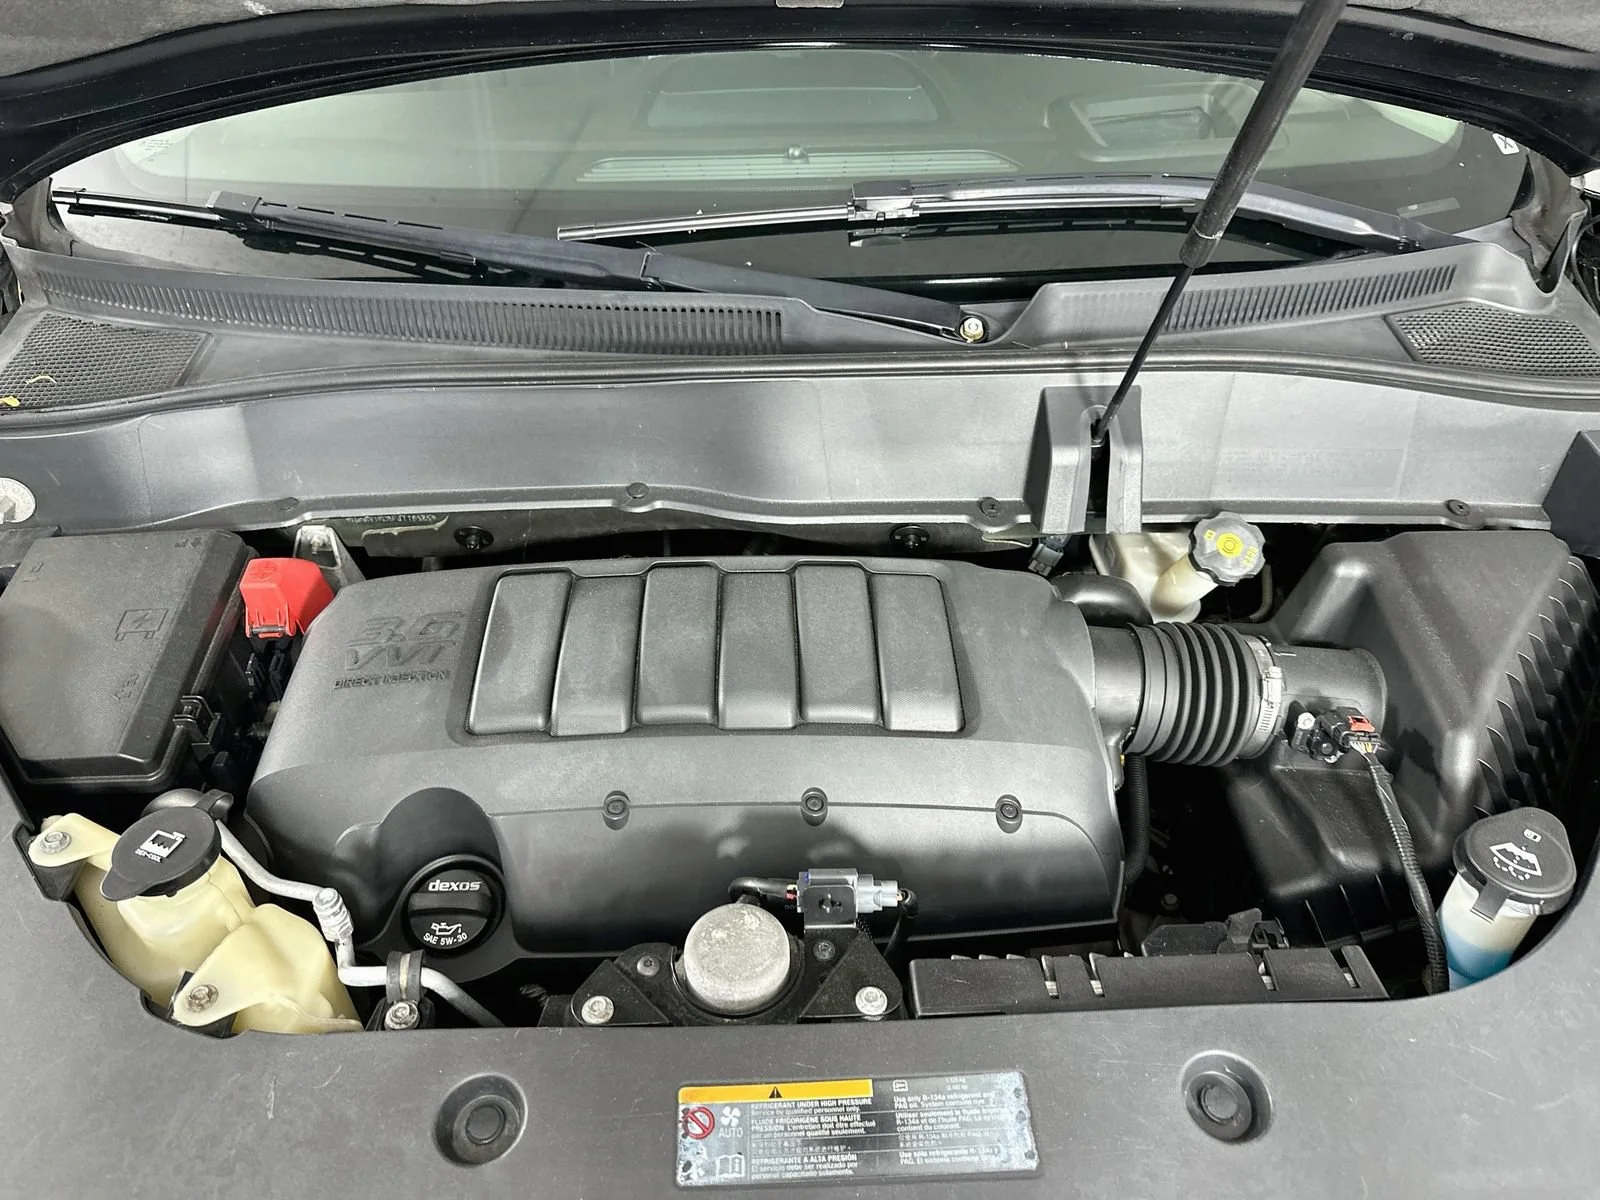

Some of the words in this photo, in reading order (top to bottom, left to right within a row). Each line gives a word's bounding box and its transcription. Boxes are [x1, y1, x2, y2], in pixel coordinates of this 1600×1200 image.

[345, 640, 457, 671] VVT
[334, 675, 380, 689] DIRECT
[382, 670, 451, 684] INJECTION
[428, 880, 482, 891] dexos
[423, 932, 439, 945] SAE
[440, 932, 468, 946] 5W-30
[947, 1092, 981, 1100] refrigerant
[751, 1101, 795, 1109] REFRIGERANT
[838, 1098, 872, 1106] PRESSURE
[921, 1100, 944, 1108] System
[945, 1099, 972, 1107] contains
[786, 1108, 812, 1116] qualified
[920, 1110, 953, 1118] seulement
[788, 1122, 820, 1131] L'entretien
[896, 1118, 919, 1126] R-134a
[719, 1127, 743, 1138] AUTO
[774, 1130, 805, 1138] personnel
[899, 1150, 912, 1158] Use
[752, 1156, 801, 1165] REFRIGERANTE
[760, 1164, 785, 1172] servicio
[751, 1172, 779, 1180] personal
